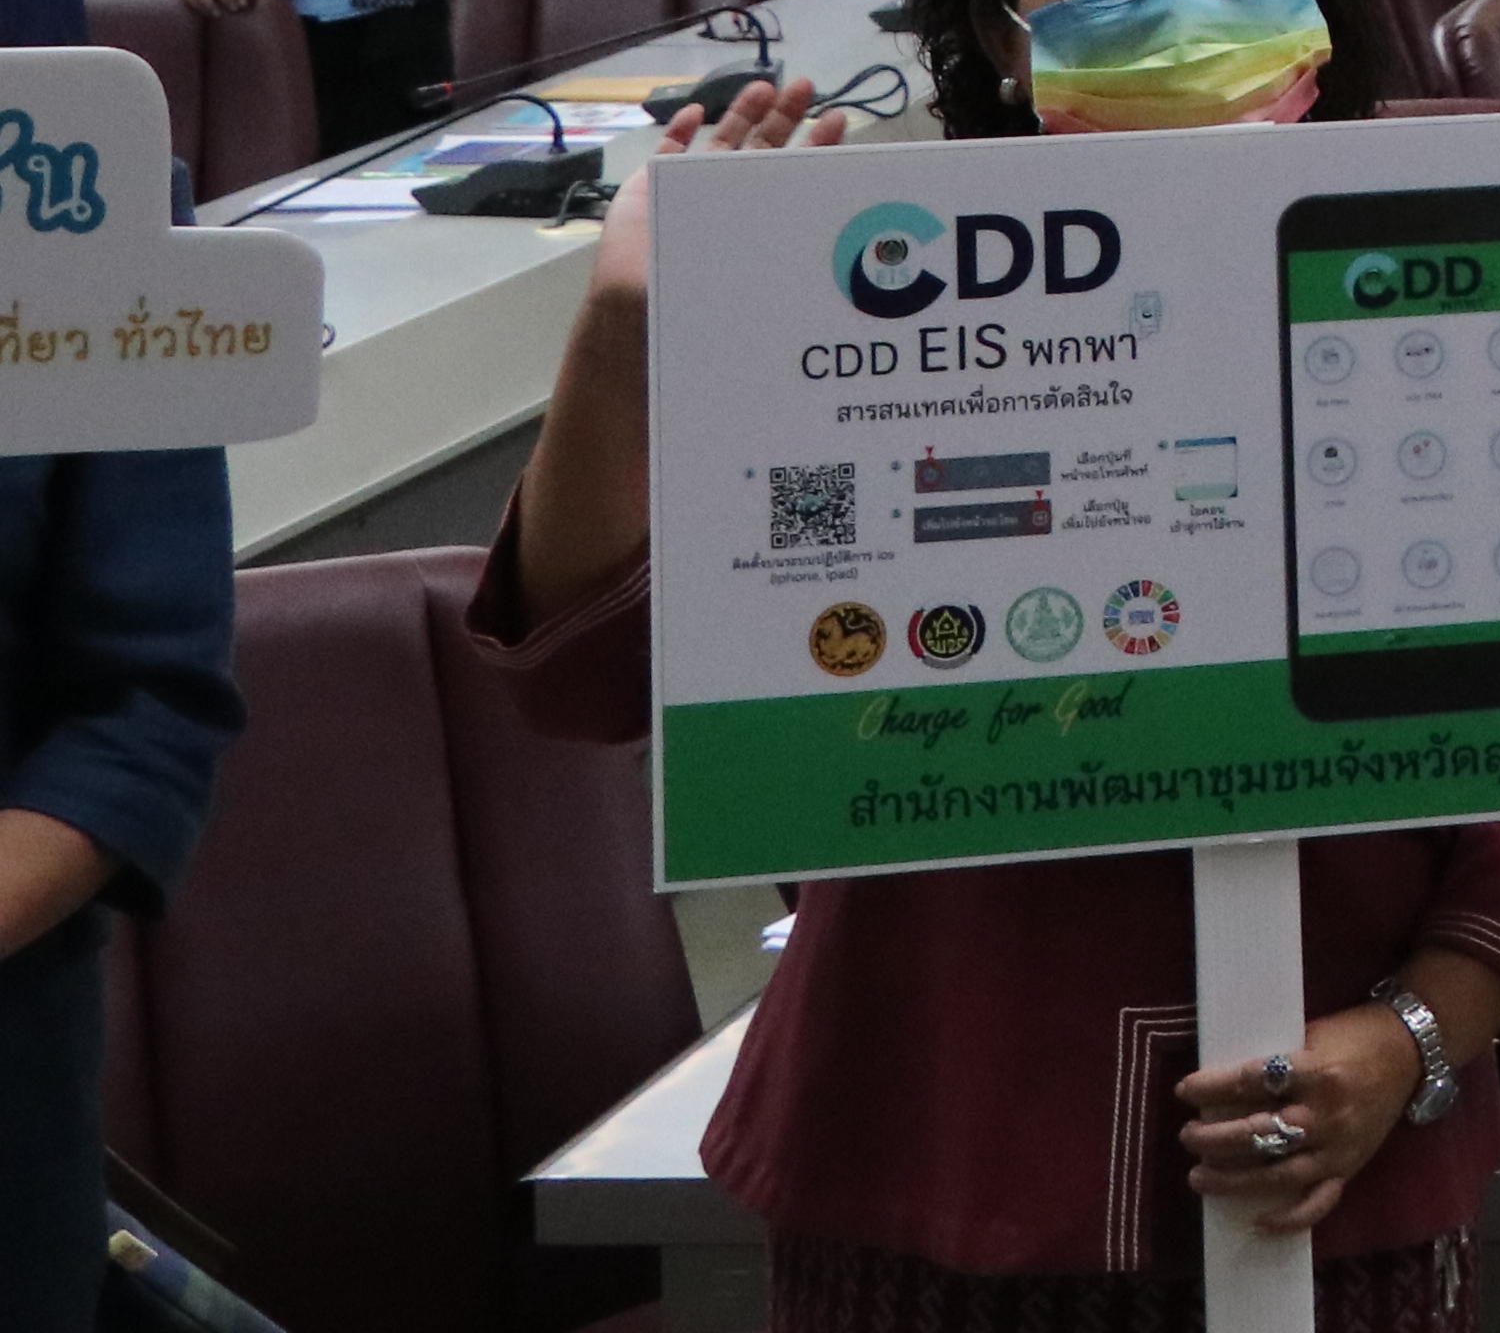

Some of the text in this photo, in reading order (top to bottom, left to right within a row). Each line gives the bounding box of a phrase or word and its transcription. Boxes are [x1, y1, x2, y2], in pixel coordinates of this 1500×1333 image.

[833, 201, 1121, 319] CDD
[1344, 252, 1483, 310] CDD
[112, 296, 273, 361] ทั่วไทย
[801, 323, 1138, 381] CDD EIS พกพา
[836, 381, 1134, 424] สารสนเทศเพื่อการตัดสินใจ
[857, 677, 1133, 749] Change for Good
